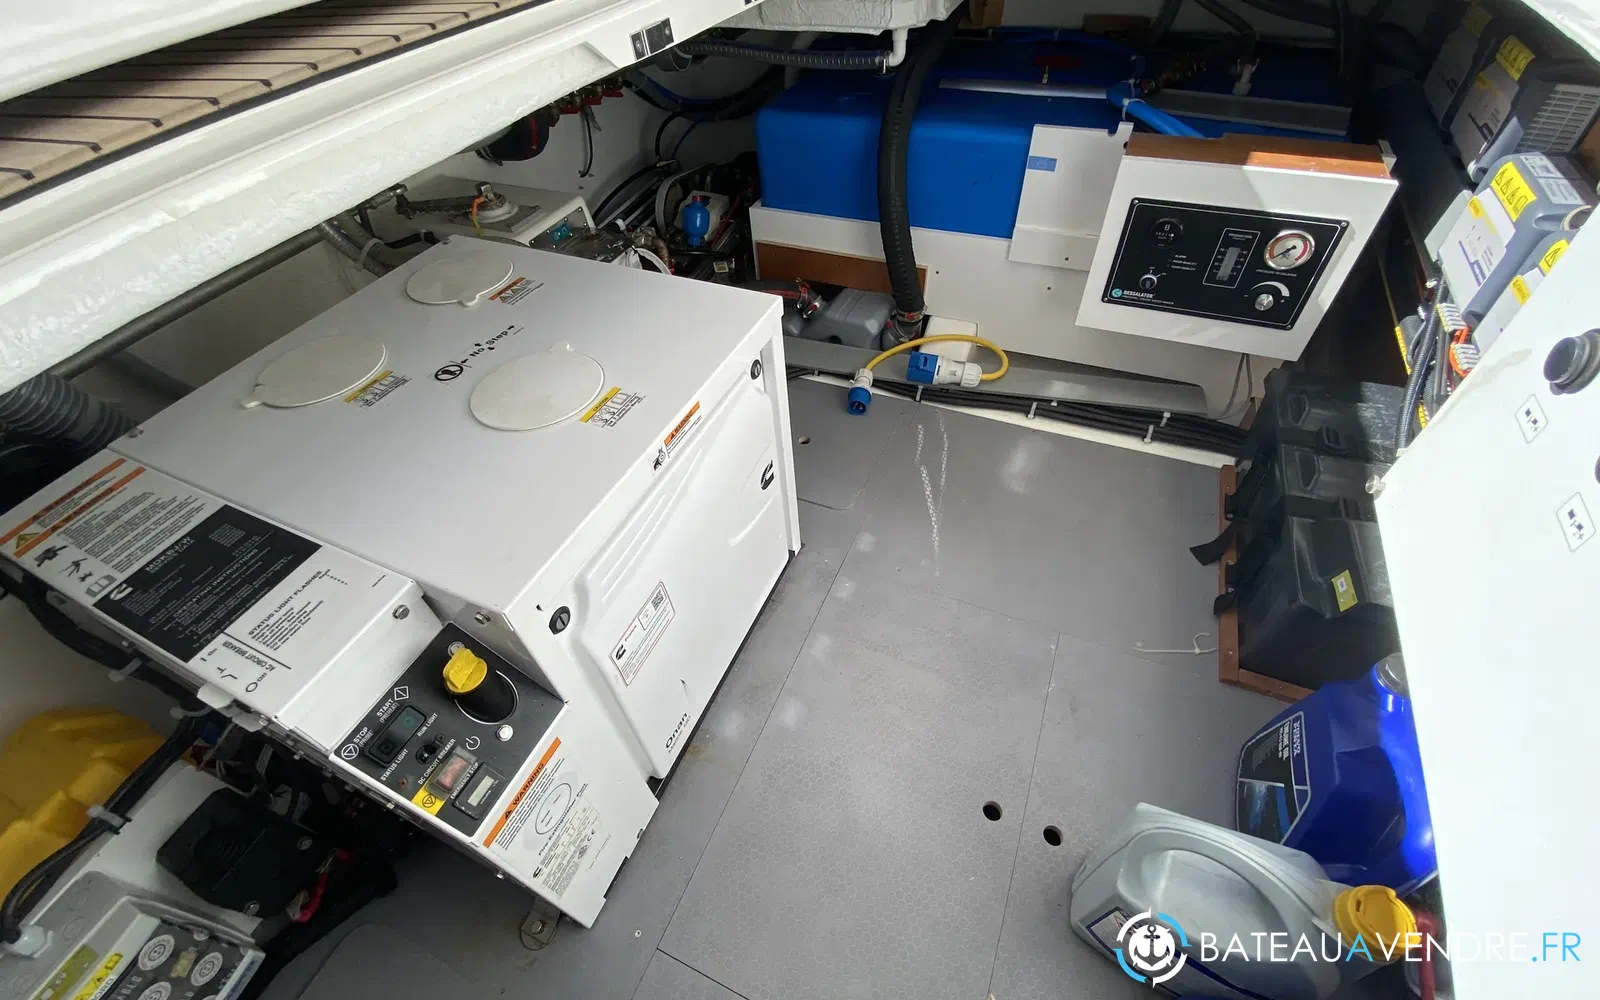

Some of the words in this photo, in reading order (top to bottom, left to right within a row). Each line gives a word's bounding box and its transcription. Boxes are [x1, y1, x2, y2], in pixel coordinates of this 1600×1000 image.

[1122, 289, 1154, 298] DESSALATOR
[468, 346, 485, 357] No
[484, 328, 509, 346] Step
[172, 584, 213, 618] OPERATING
[211, 547, 259, 586] INSTRUCTIONS
[247, 611, 275, 636] STATUS
[272, 593, 295, 613] LIGHT
[292, 569, 323, 596] FLASHES
[221, 640, 247, 657] BREAKER
[244, 652, 267, 667] CIRCUIT
[375, 696, 394, 718] START
[378, 700, 400, 724] (PREHEAT)
[352, 725, 370, 744] STOP
[416, 724, 428, 737] RUN
[424, 711, 439, 727] LIGHT
[664, 711, 688, 749] Onan
[379, 761, 398, 782] STATUS
[394, 747, 409, 764] LIGHT
[416, 775, 426, 785] DC
[422, 757, 440, 778] CIRCUIT
[437, 737, 456, 760] BREAKER
[449, 772, 471, 799] EMERGENCY
[467, 760, 480, 775] STOP
[511, 761, 544, 806] WARNING
[547, 798, 577, 841] Extinguisher
[575, 782, 586, 798] Port
